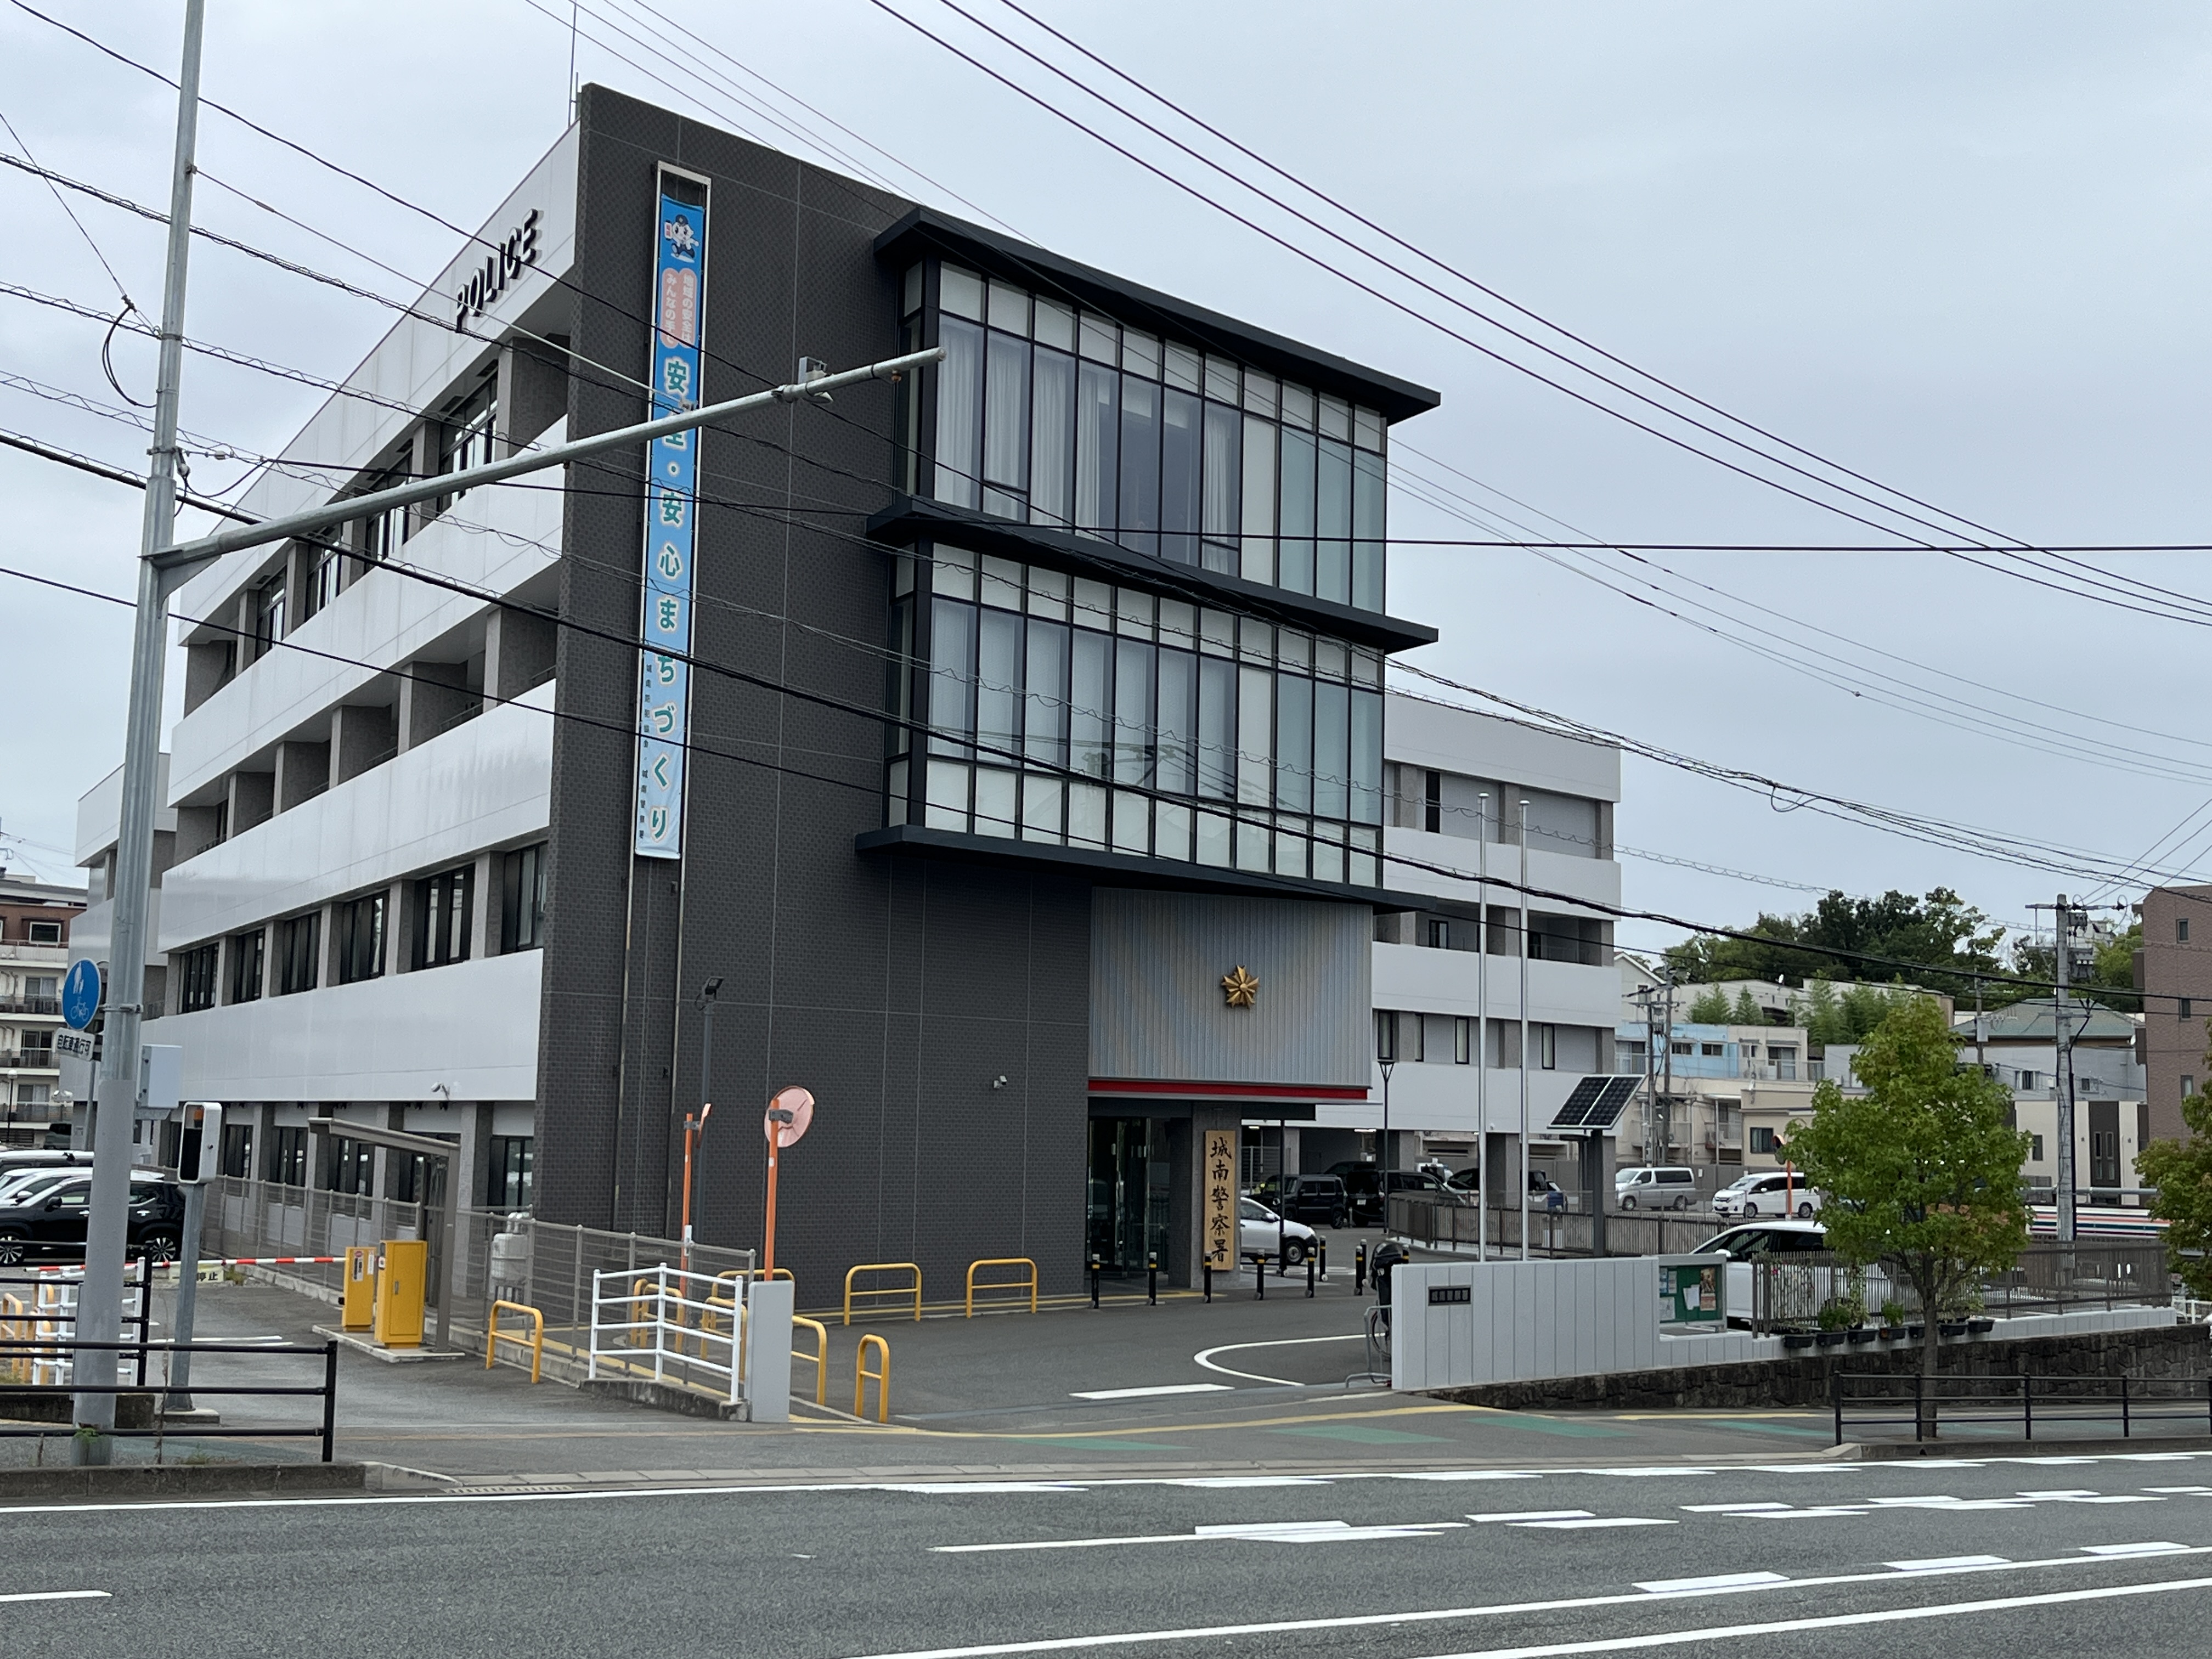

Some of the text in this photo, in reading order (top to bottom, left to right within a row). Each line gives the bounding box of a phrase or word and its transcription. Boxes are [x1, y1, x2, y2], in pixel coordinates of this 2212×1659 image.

[454, 208, 539, 334] POLICE
[57, 1035, 91, 1056] 自転車通行可
[1209, 1137, 1232, 1262] 城南警察署
[172, 1272, 218, 1282] 一停止
